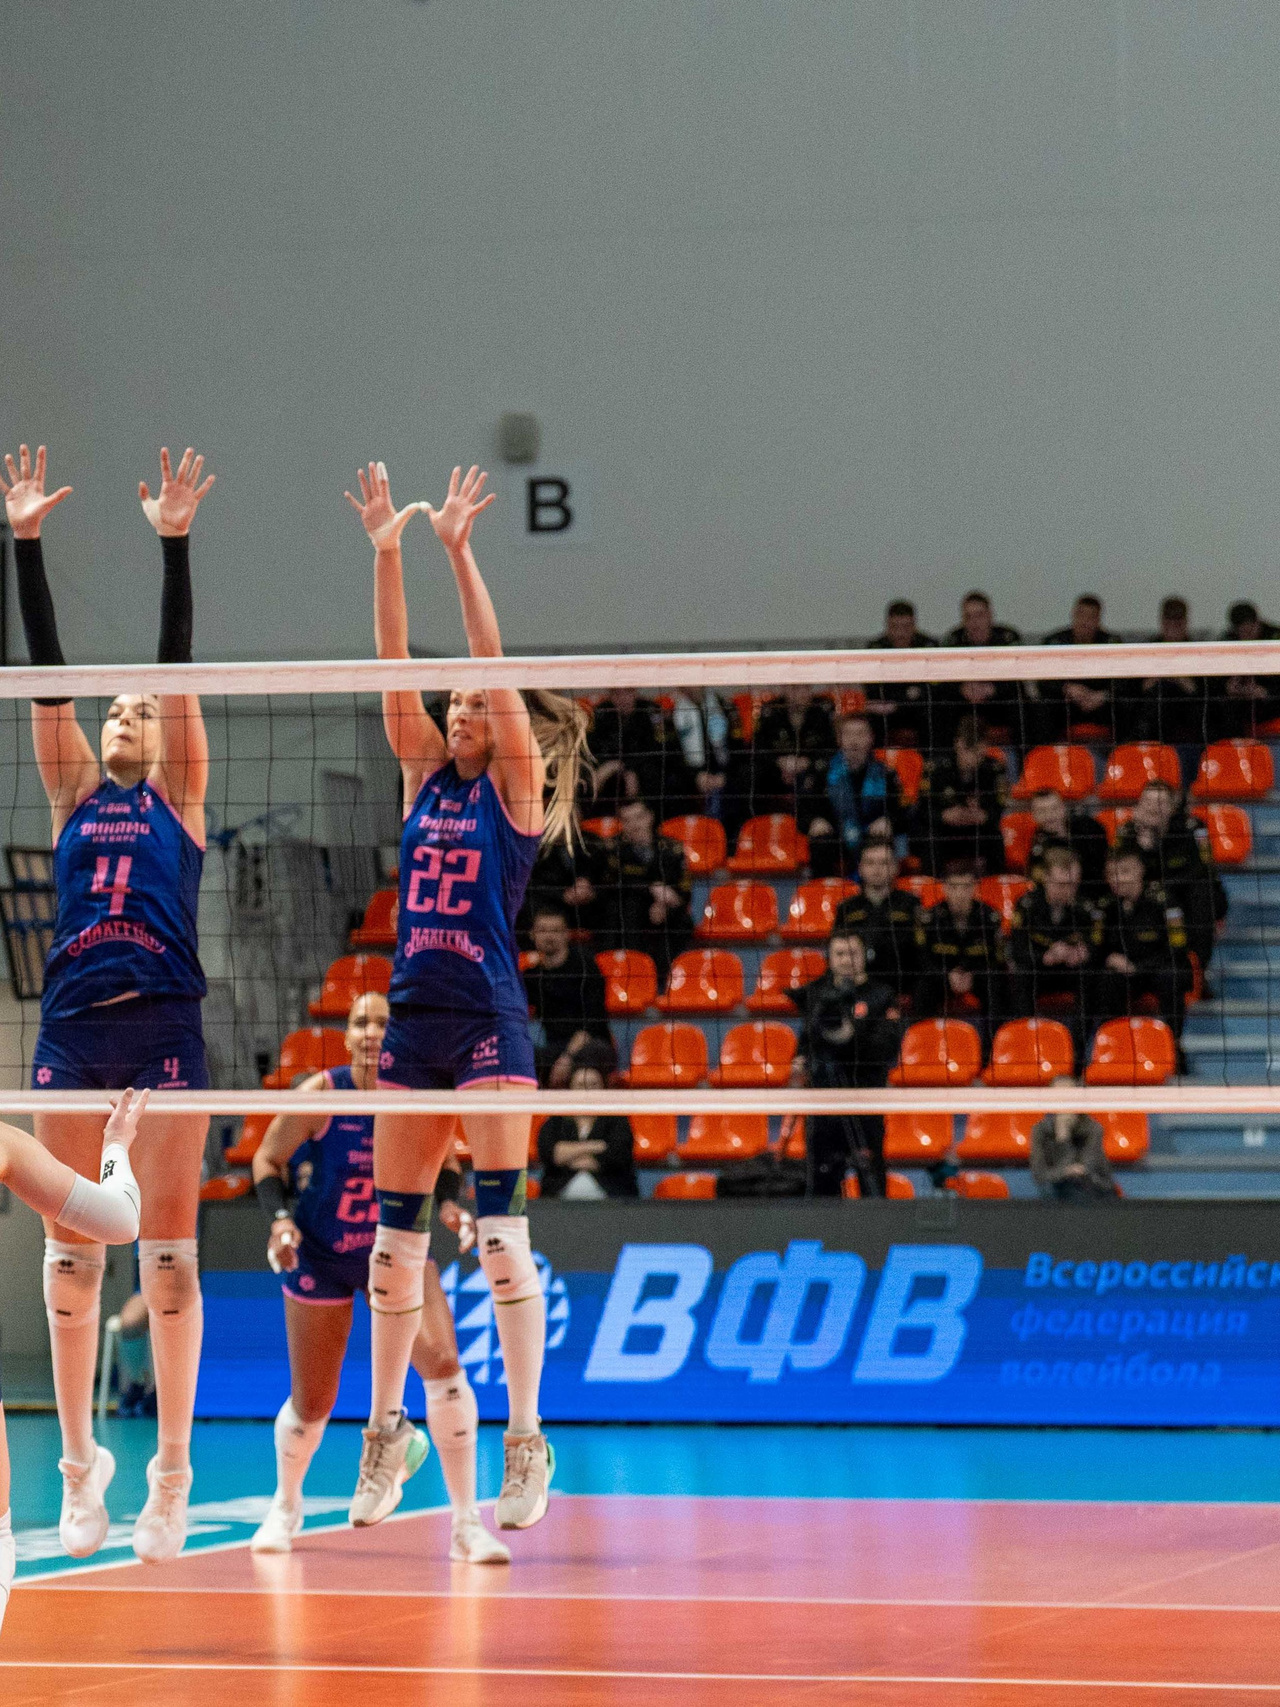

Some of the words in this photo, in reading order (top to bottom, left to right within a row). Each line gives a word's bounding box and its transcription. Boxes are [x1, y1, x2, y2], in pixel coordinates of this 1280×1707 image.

[91, 856, 133, 916] 4
[406, 845, 482, 916] 22
[163, 1057, 179, 1080] 4
[583, 1240, 984, 1384] ВФВ
[1011, 1301, 1249, 1343] федерация
